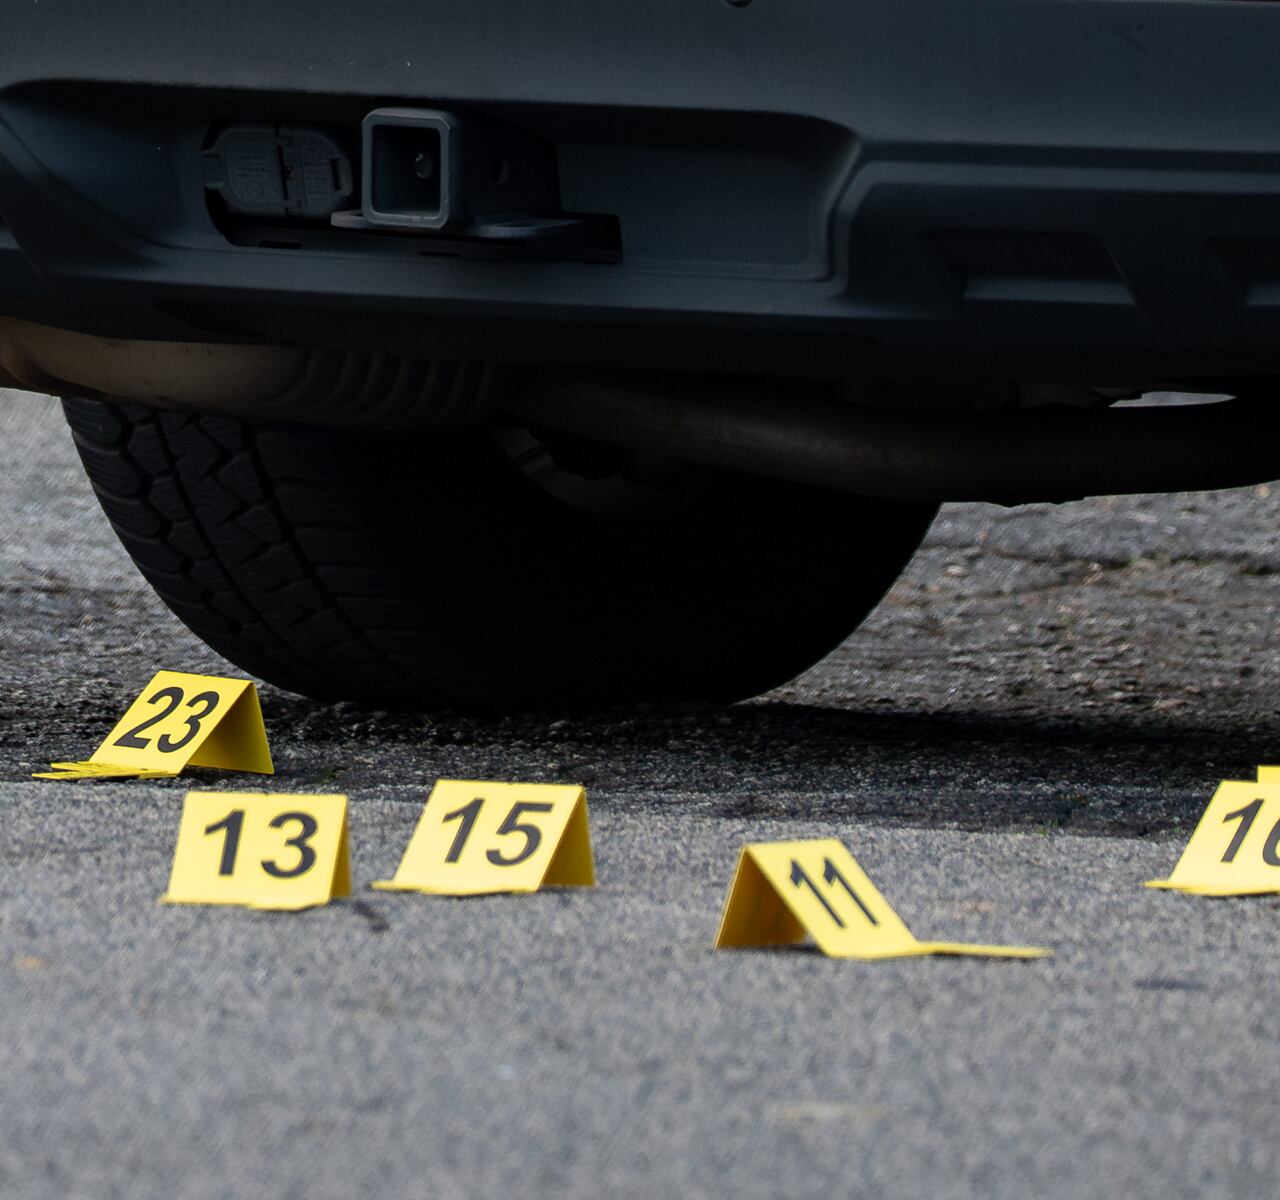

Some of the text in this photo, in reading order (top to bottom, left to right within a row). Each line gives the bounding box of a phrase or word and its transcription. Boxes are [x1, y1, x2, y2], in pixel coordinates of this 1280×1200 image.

[112, 686, 220, 754] 23
[204, 809, 319, 879] 13
[442, 798, 554, 866] 15
[789, 858, 877, 928] 11
